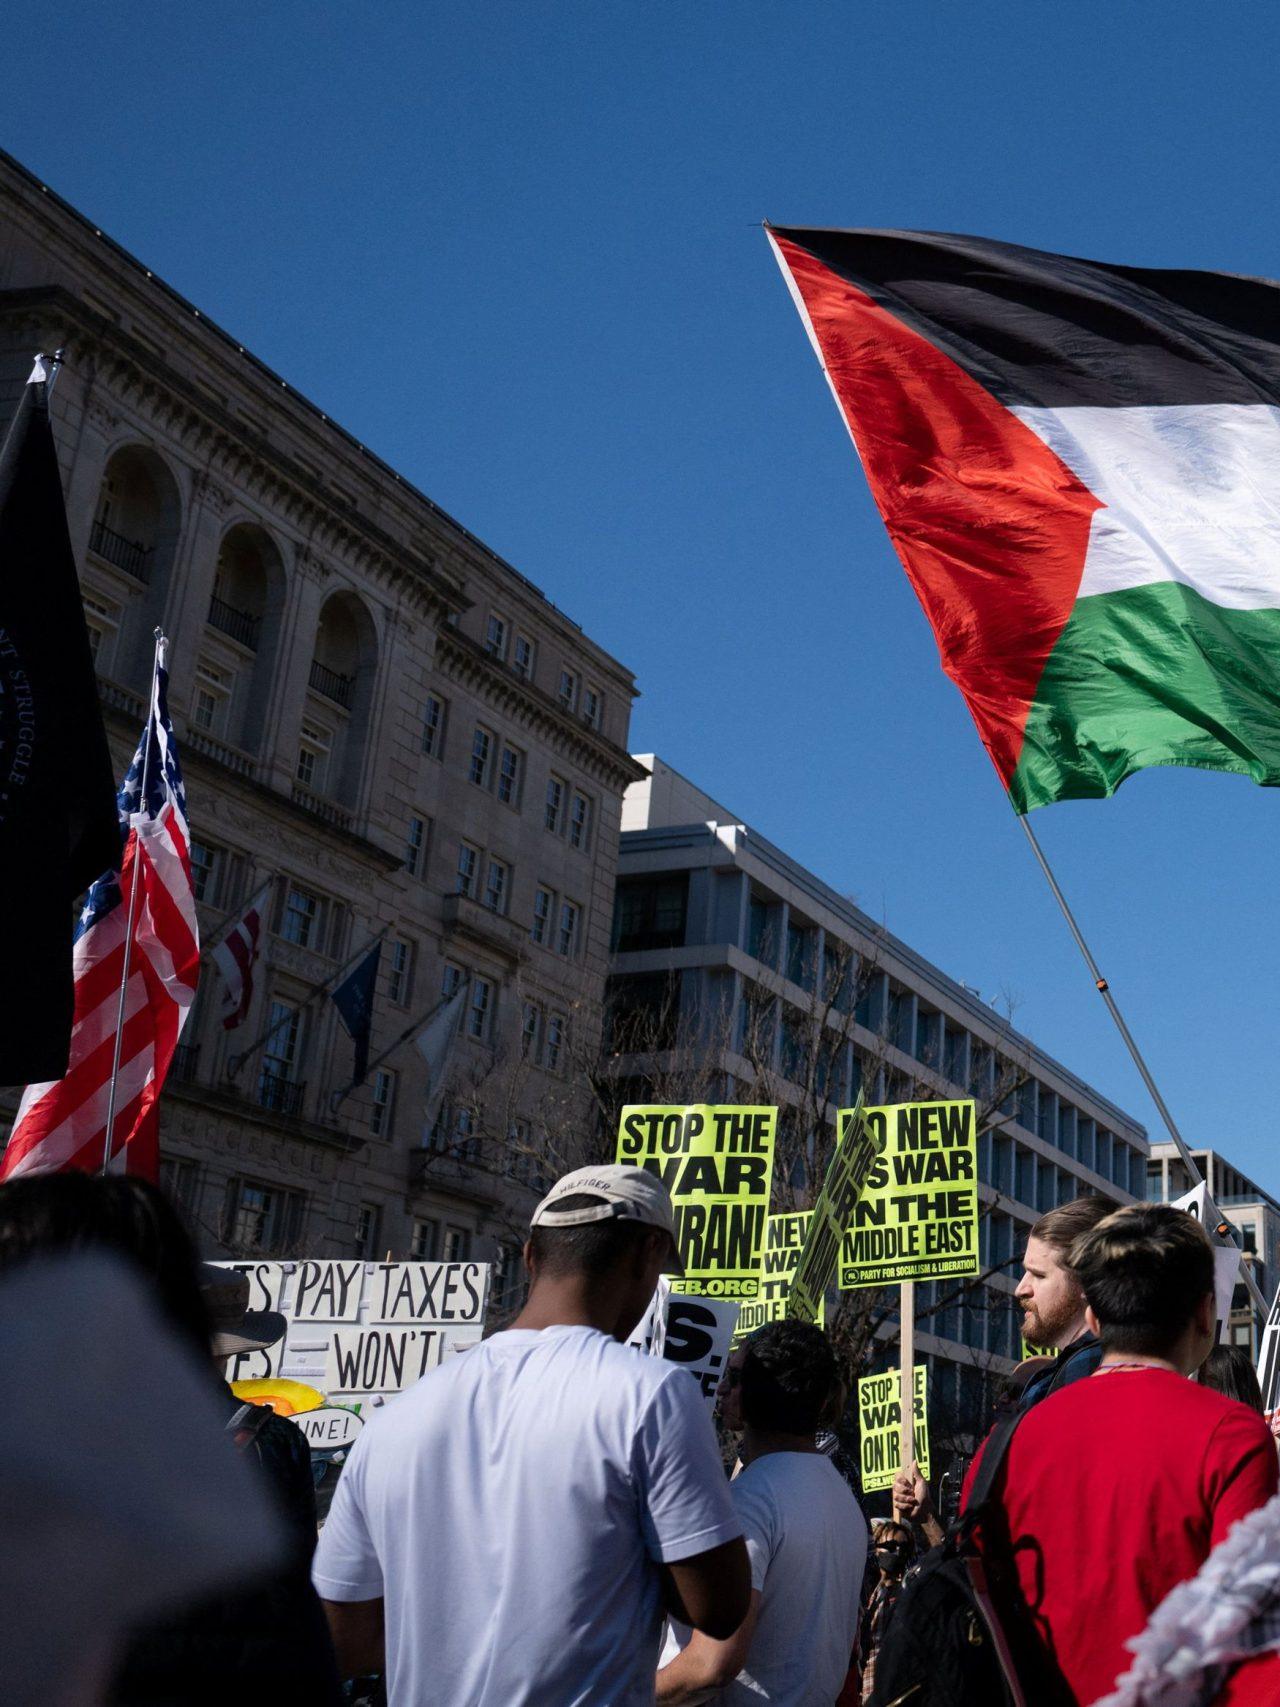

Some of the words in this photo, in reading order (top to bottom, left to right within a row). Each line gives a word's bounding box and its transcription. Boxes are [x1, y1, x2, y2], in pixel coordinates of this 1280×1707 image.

[8, 669, 35, 785] STRUGGLE
[622, 1114, 704, 1154] STOP
[713, 1113, 771, 1153] THE
[897, 1105, 972, 1151] NEW
[560, 1178, 611, 1193] HILFIGER
[893, 1150, 974, 1186] WAR
[891, 1190, 973, 1223] THE
[673, 1204, 766, 1269] IRAN!
[843, 1225, 919, 1264] MIDDLE
[925, 1219, 973, 1255] EAST
[764, 1250, 803, 1274] WA
[861, 1269, 881, 1280] PARTY
[882, 1267, 895, 1278] FOR
[896, 1263, 931, 1276] SOCIALISM
[932, 1263, 937, 1273] &
[939, 1259, 976, 1272] LIBERATION
[295, 1261, 360, 1318] PAY
[379, 1263, 479, 1320] TAXES
[670, 1280, 758, 1295] EB.ORG
[762, 1278, 792, 1300] TH
[737, 1302, 780, 1331] IDDLE
[334, 1331, 437, 1390] WON'T
[861, 1377, 893, 1406] STOP
[863, 1434, 885, 1473] ON
[887, 1424, 927, 1469] IRN!
